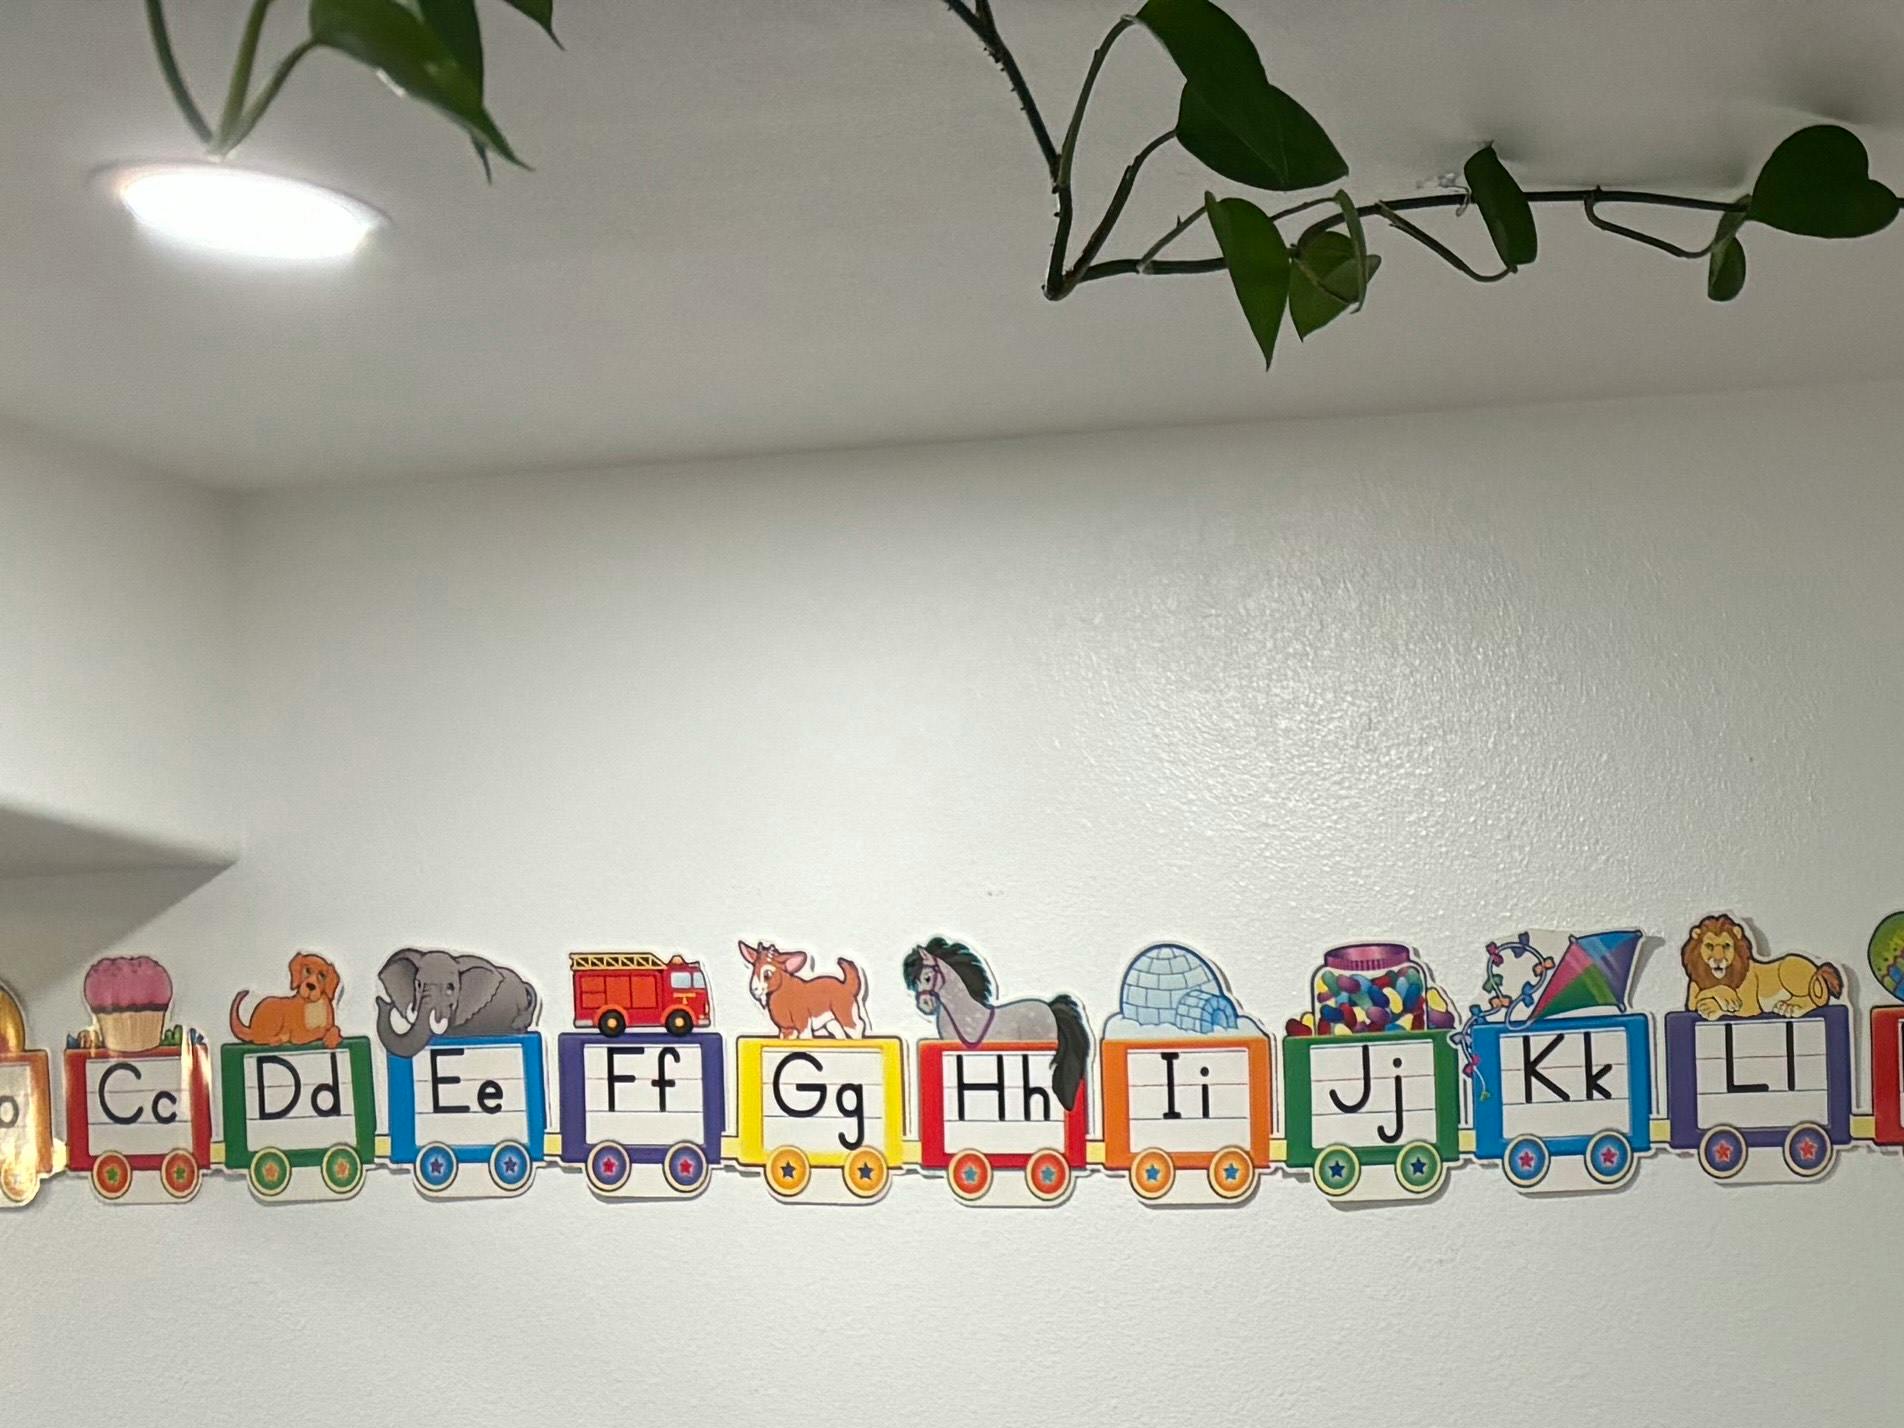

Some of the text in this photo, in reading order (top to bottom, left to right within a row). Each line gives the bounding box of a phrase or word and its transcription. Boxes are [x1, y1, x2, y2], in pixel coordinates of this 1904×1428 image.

[98, 1062, 177, 1125] Cc
[257, 1055, 342, 1121] Dd
[429, 1048, 504, 1115] Ee
[606, 1047, 680, 1113] Ff
[772, 1051, 865, 1151] Gg
[956, 1053, 1051, 1122] Hh
[1160, 1051, 1210, 1120] Ii
[1329, 1044, 1404, 1144] Jj
[1522, 1031, 1613, 1104] Kk
